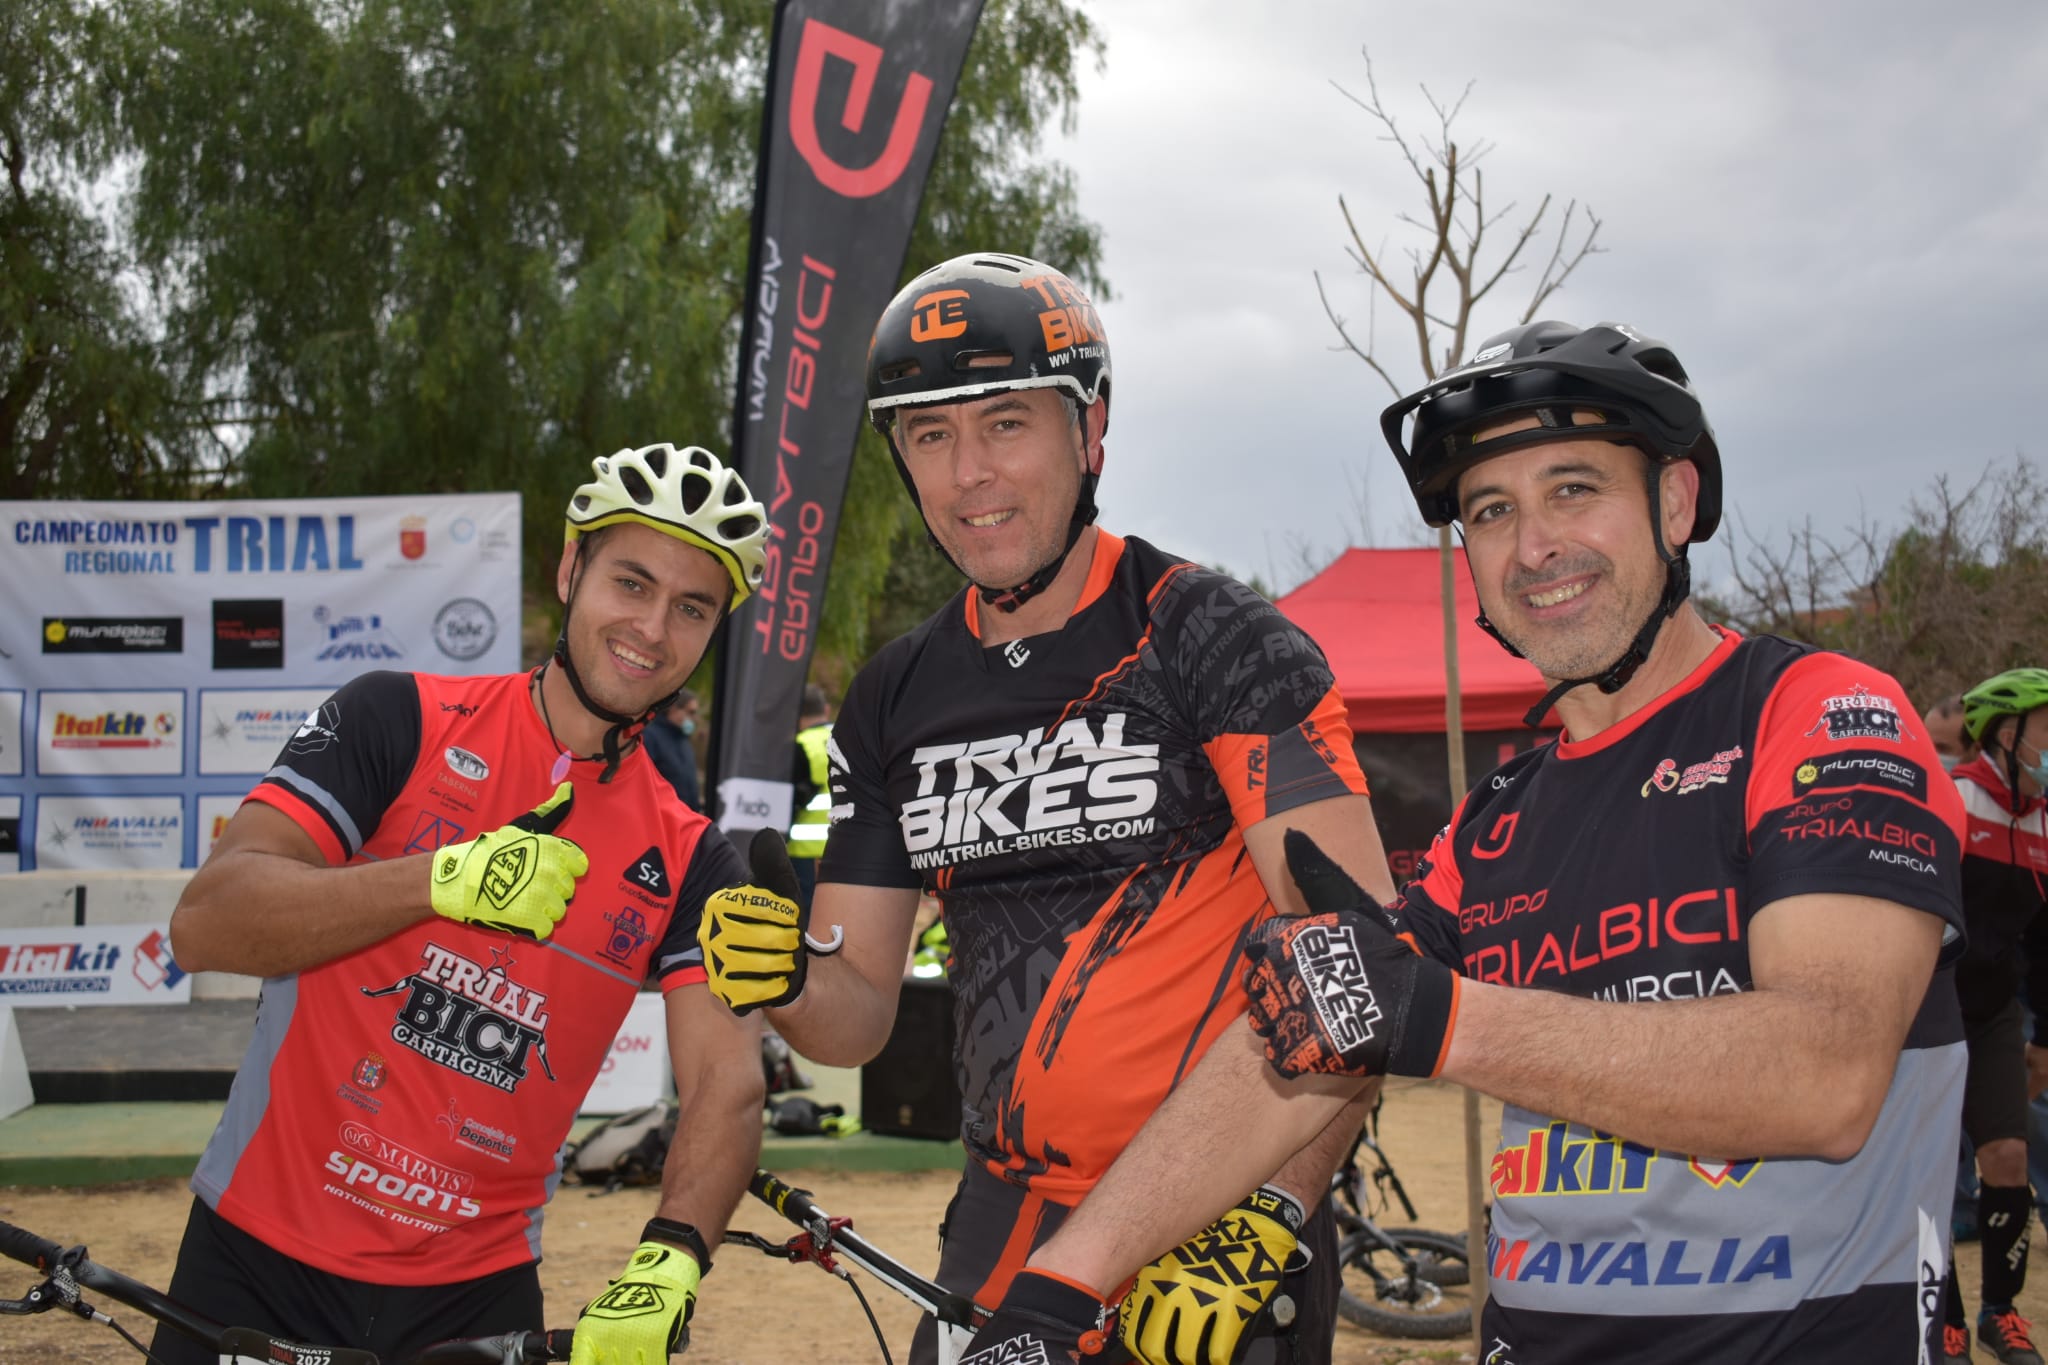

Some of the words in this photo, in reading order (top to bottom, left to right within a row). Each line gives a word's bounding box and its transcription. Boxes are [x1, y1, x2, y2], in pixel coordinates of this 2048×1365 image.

[15, 520, 177, 544] CAMPEONATO
[184, 516, 364, 573] TRIAL
[65, 551, 175, 573] REGIONAL
[1822, 693, 1898, 713] TRIAL
[1823, 708, 1899, 735] BICI
[53, 711, 147, 736] italkit
[1828, 727, 1901, 742] CARTAGENA
[911, 713, 1160, 798] TRIAL
[1823, 758, 1915, 780] mundobici
[438, 772, 478, 800] TABERNA
[900, 757, 1160, 852] BIKES
[1780, 818, 1937, 857] TRIALBICI
[1868, 849, 1938, 875] MURCIA
[1459, 889, 1549, 935] GRUPO
[1464, 887, 1740, 987] TRIALBICI
[419, 942, 549, 1031] TRIAL
[1294, 940, 1347, 1052] WWW.TRIAL-BIKES.COM
[1299, 930, 1360, 1046] BIKES
[1328, 926, 1383, 1043] TRIAL
[1593, 967, 1742, 1003] MURCIA
[396, 976, 541, 1079] BICI
[393, 1024, 516, 1092] CARTAGENA
[459, 1126, 513, 1155] Deportes
[325, 1151, 482, 1218] SPORTS
[377, 1142, 465, 1193] MARNYS
[323, 1183, 387, 1218] NATURAL
[269, 1338, 332, 1356] CAMPEONATO
